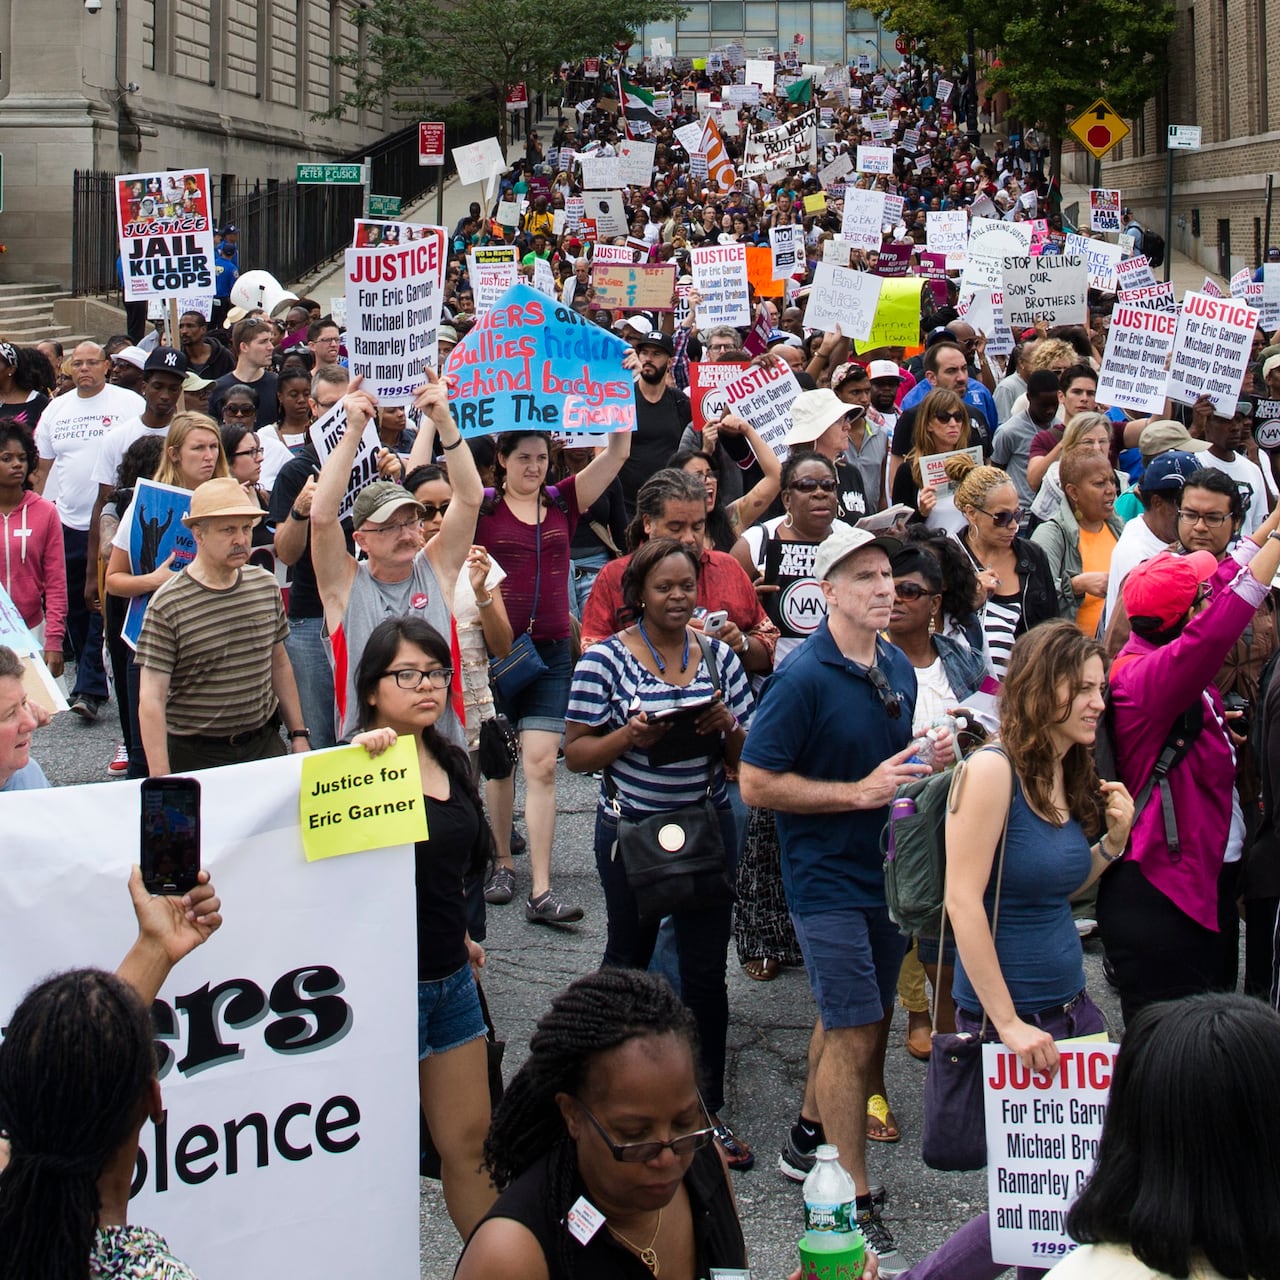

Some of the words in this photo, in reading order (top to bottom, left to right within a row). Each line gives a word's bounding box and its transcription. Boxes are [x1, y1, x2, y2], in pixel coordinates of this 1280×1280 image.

[300, 170, 323, 179] PETER
[325, 170, 331, 179] P
[332, 170, 358, 179] CUSICK
[1093, 210, 1118, 219] JAIL
[125, 217, 208, 238] JUSTICE
[1100, 222, 1120, 230] COPS
[775, 230, 793, 243] NO!
[129, 235, 204, 260] JAIL
[594, 246, 633, 261] JUSTICE
[693, 246, 745, 266] JUSTICE
[879, 253, 898, 261] NYPD
[129, 255, 209, 277] KILLER
[349, 242, 439, 283] JUSTICE
[1004, 256, 1032, 270] STOP
[1036, 255, 1082, 270] KILLING
[1116, 256, 1148, 274] JUSTICE
[152, 271, 212, 291] COPS
[700, 279, 722, 289] Michael
[723, 277, 742, 288] Brown
[832, 268, 863, 291] End
[1030, 272, 1052, 283] OUR
[1092, 275, 1114, 291] ALL
[359, 289, 378, 308] For
[382, 286, 404, 307] Eric
[406, 280, 434, 304] Garner
[1007, 283, 1036, 296] SONS
[1118, 282, 1172, 302] RESPECT
[1025, 294, 1076, 309] BROTHERS
[361, 309, 405, 332] Michael
[407, 304, 434, 329] Brown
[1010, 310, 1056, 323] FATHERS
[1113, 308, 1176, 335] JUSTICE
[1184, 296, 1258, 330] JUSTICE
[1114, 330, 1128, 343] For
[1128, 332, 1143, 345] Eric
[1144, 335, 1170, 350] Garner
[1185, 318, 1200, 333] For
[1201, 322, 1217, 338] Eric
[1218, 326, 1247, 345] Garner
[354, 334, 407, 358] Ramarley
[409, 328, 437, 353] Graham
[1183, 335, 1213, 355] Michael
[1214, 342, 1241, 362] Brown
[1113, 345, 1141, 360] Michael
[1141, 349, 1166, 365] Brown
[1105, 359, 1139, 377] Ramarley
[1139, 365, 1167, 381] Graham
[1175, 351, 1211, 374] Ramarley
[1212, 360, 1243, 380] Graham
[725, 359, 790, 404] JUSTICE
[1101, 375, 1114, 387] and
[1115, 378, 1134, 393] many
[1172, 368, 1185, 382] and
[1185, 372, 1206, 390] many
[737, 405, 753, 418] For
[750, 393, 769, 410] Eric
[766, 380, 793, 400] Garner
[1114, 393, 1148, 405] 1199SEIU
[511, 394, 559, 423] The
[562, 394, 637, 433] Enemy
[789, 597, 828, 616] NAN
[311, 774, 374, 797] Justice
[380, 768, 407, 782] for
[308, 810, 342, 830] Eric
[348, 799, 416, 820] Garner
[997, 1167, 1069, 1200] Ramarley
[997, 1204, 1023, 1229] and
[1028, 1209, 1068, 1236] many
